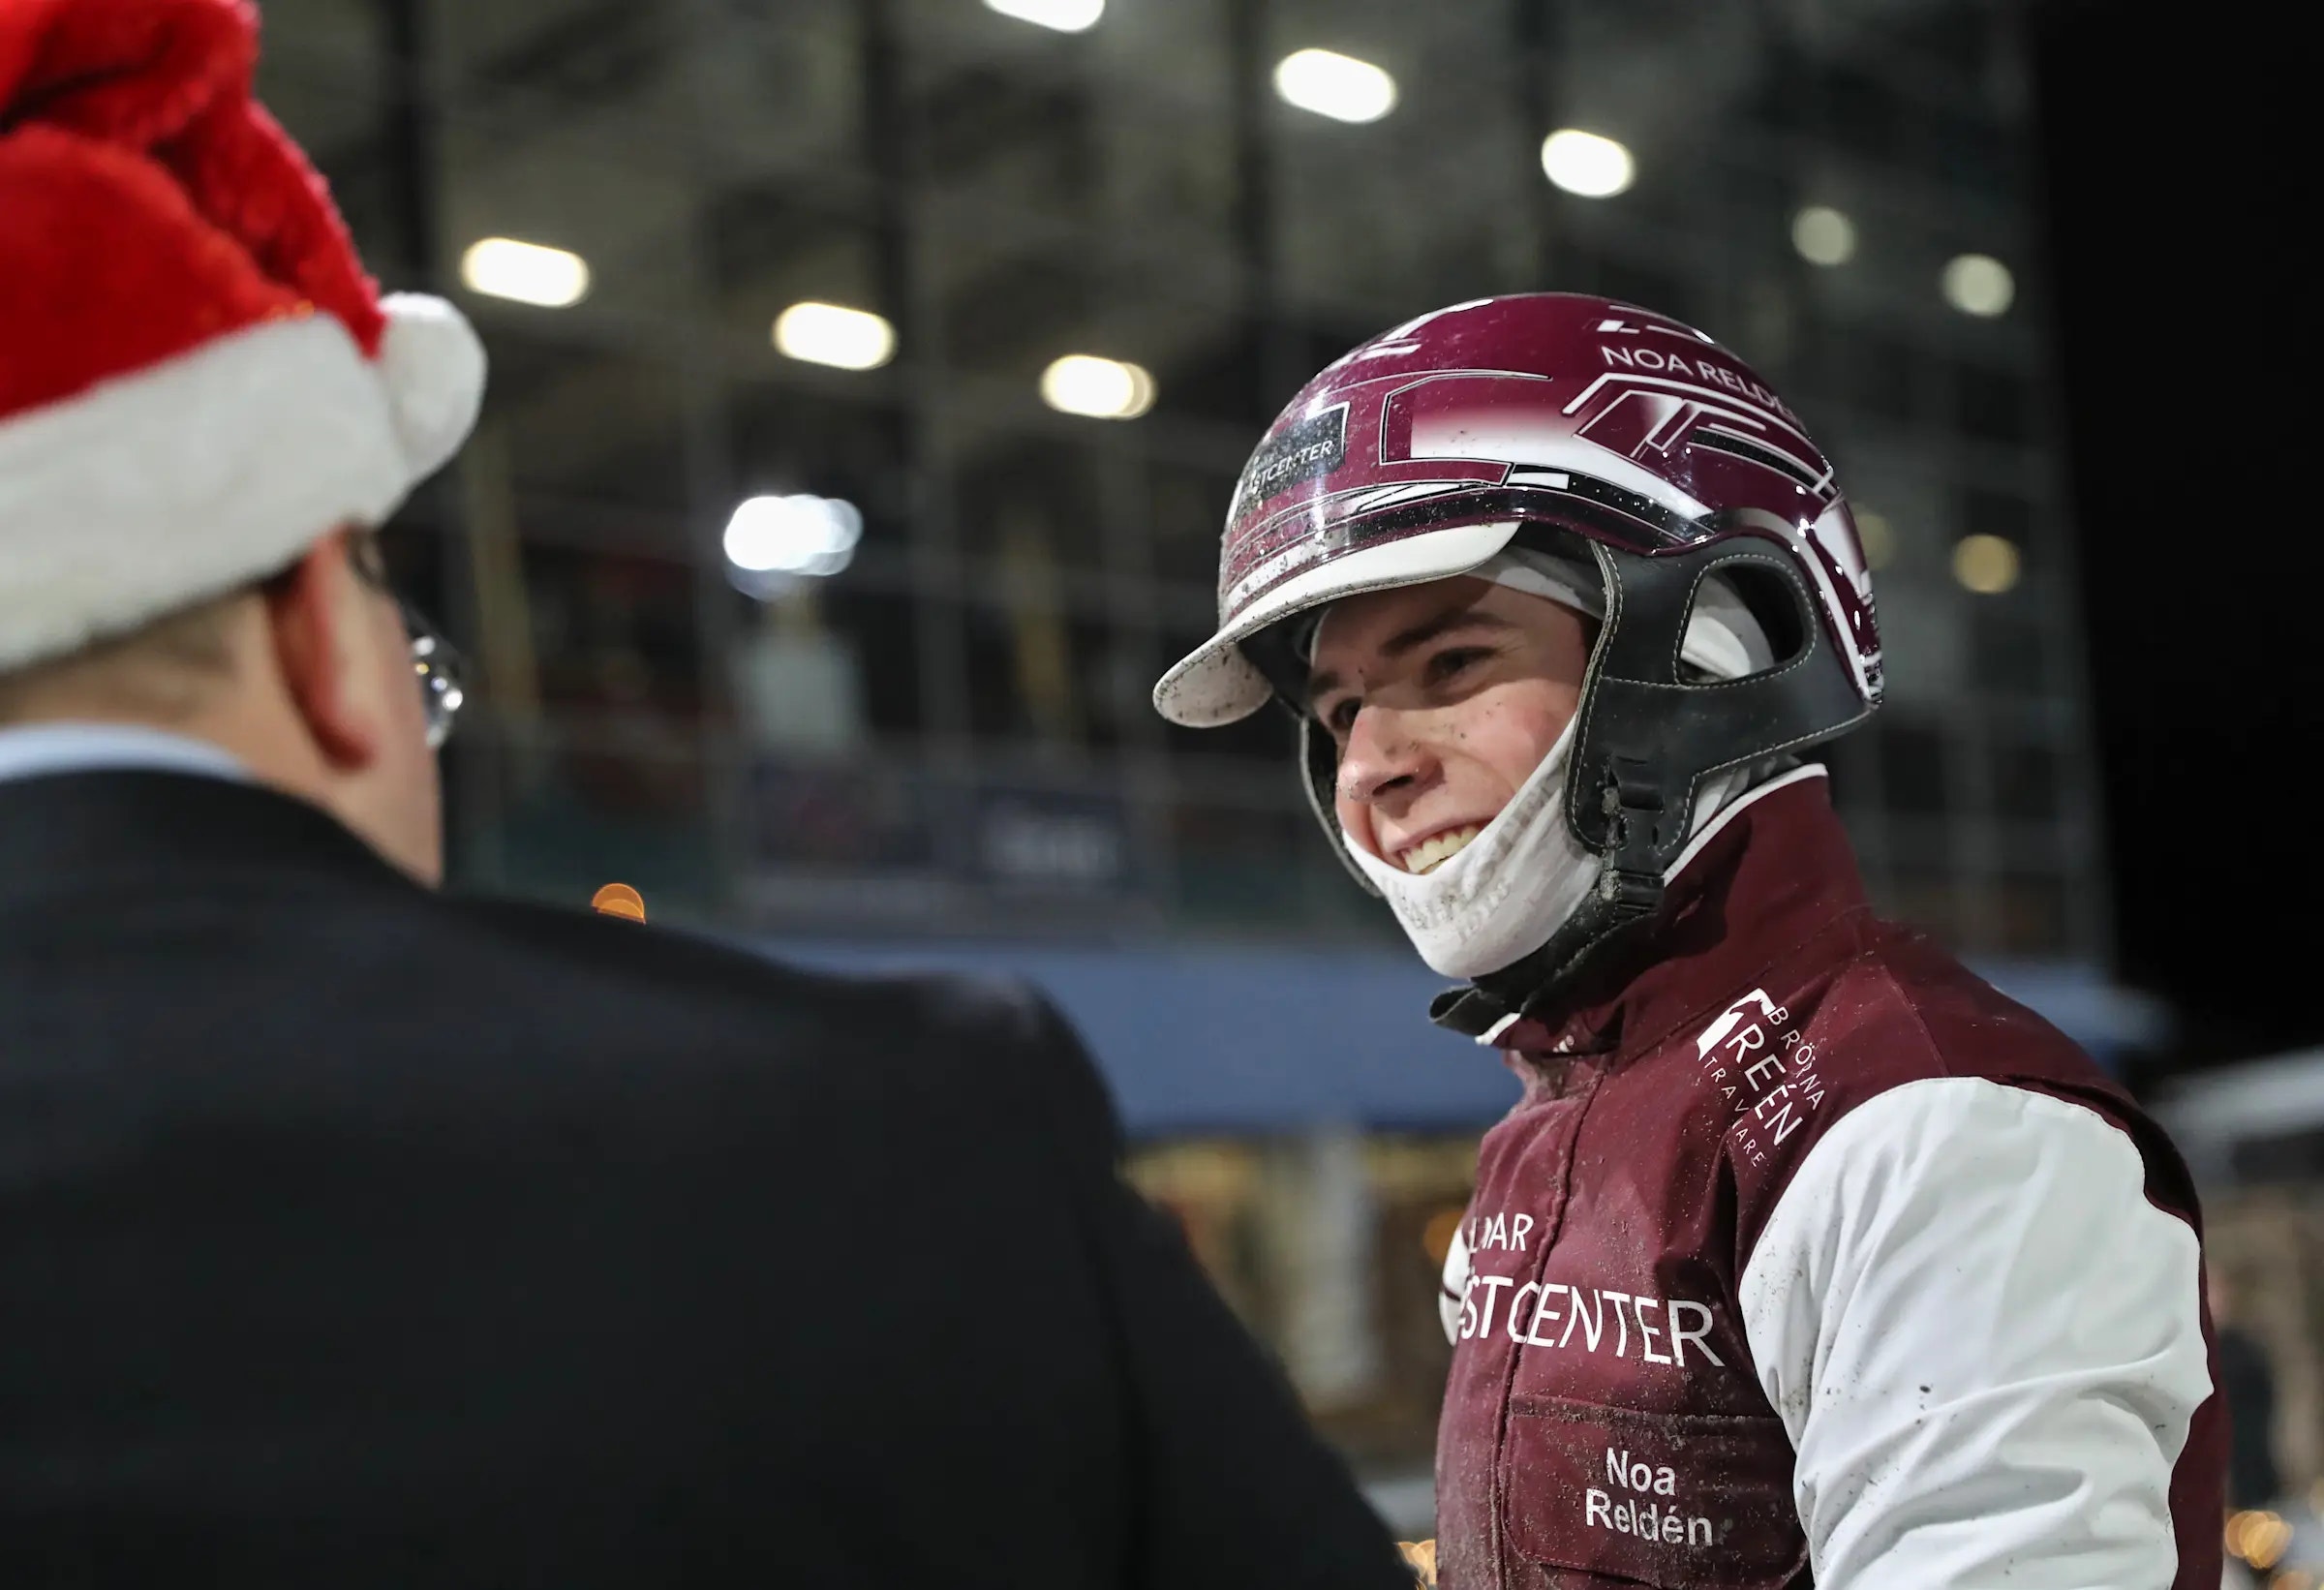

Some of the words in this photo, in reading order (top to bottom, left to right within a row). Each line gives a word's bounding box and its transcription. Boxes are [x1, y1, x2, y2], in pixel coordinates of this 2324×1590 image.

[1601, 346, 1694, 376] NOA
[1457, 1274, 1726, 1367] STCENTER
[1605, 1447, 1676, 1496] Noa
[1585, 1487, 1713, 1546] Reldén
